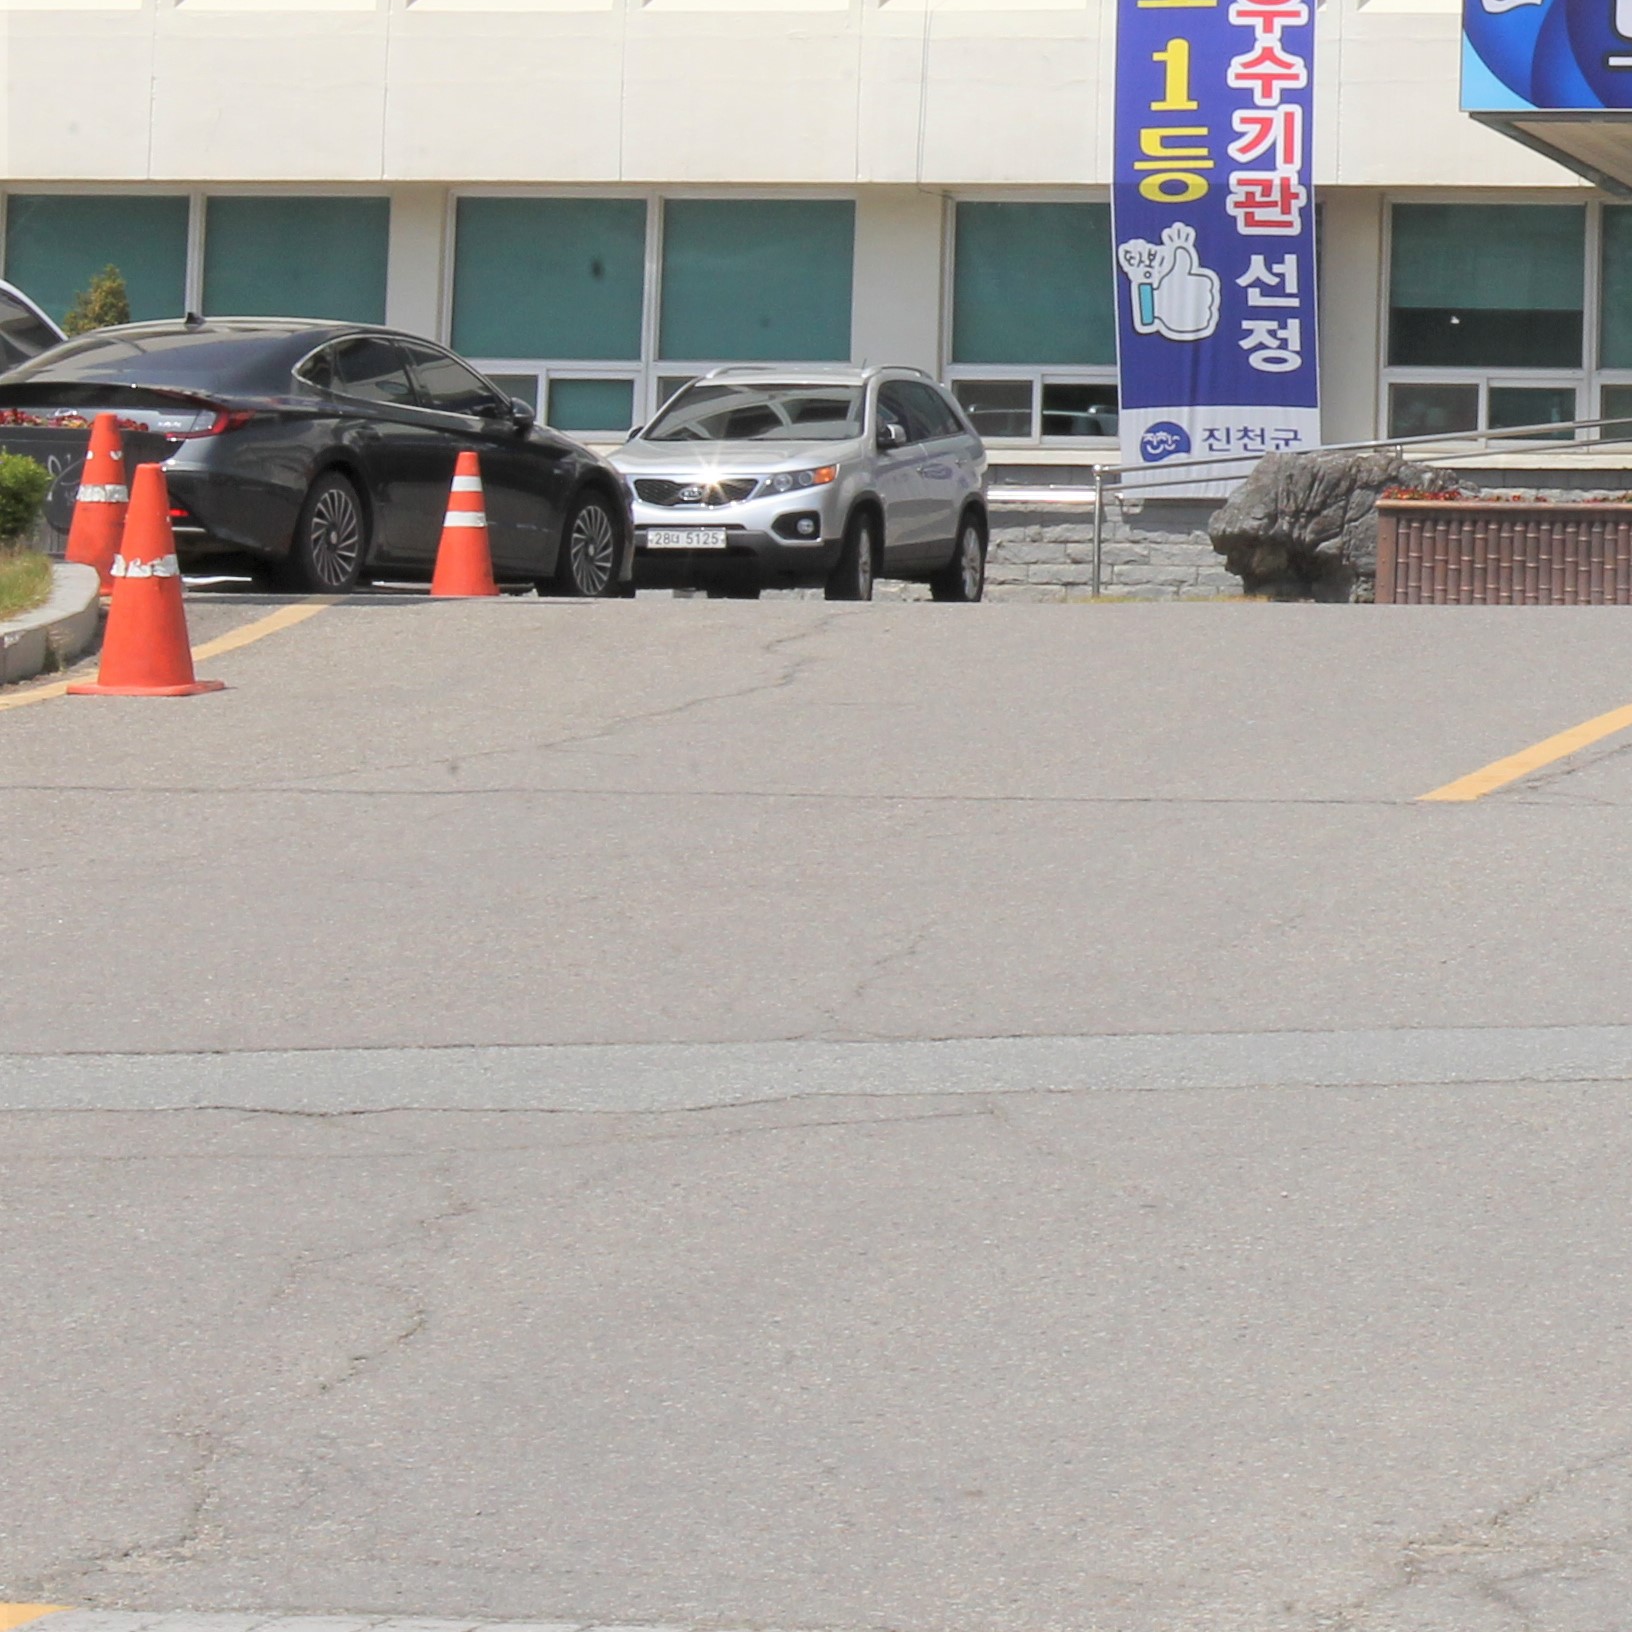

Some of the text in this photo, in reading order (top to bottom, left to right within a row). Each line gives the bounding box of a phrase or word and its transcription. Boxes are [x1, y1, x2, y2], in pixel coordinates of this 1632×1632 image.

[1134, 38, 1216, 203] 1등
[1235, 254, 1302, 373] 선정
[1202, 426, 1303, 453] 진천군
[686, 533, 719, 545] 5125
